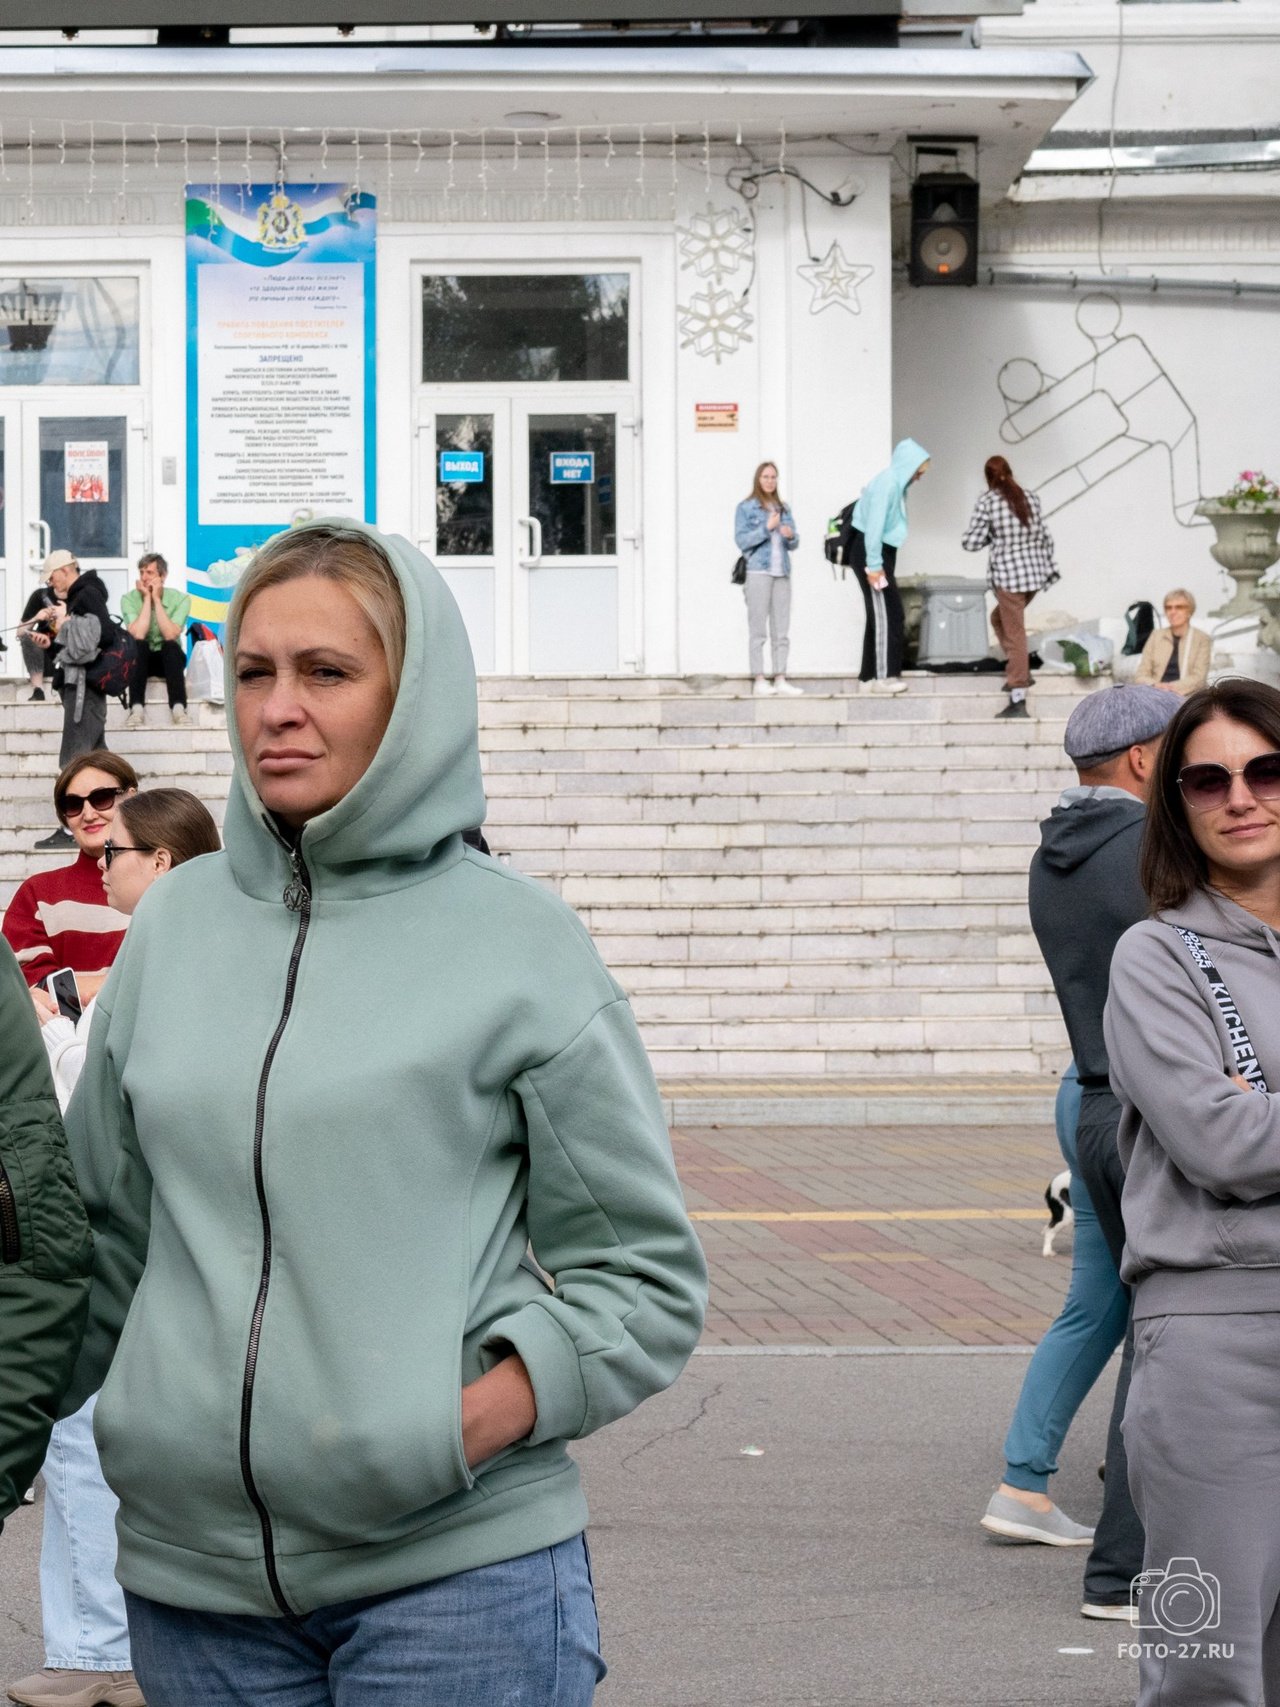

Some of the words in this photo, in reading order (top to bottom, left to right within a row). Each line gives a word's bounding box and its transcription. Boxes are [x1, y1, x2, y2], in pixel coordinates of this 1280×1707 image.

[259, 355, 303, 363] ЗАПРЕЩЕНО
[445, 461, 479, 473] ВЫХОД
[555, 458, 590, 468] ВХОДА
[562, 469, 581, 478] НЕТ
